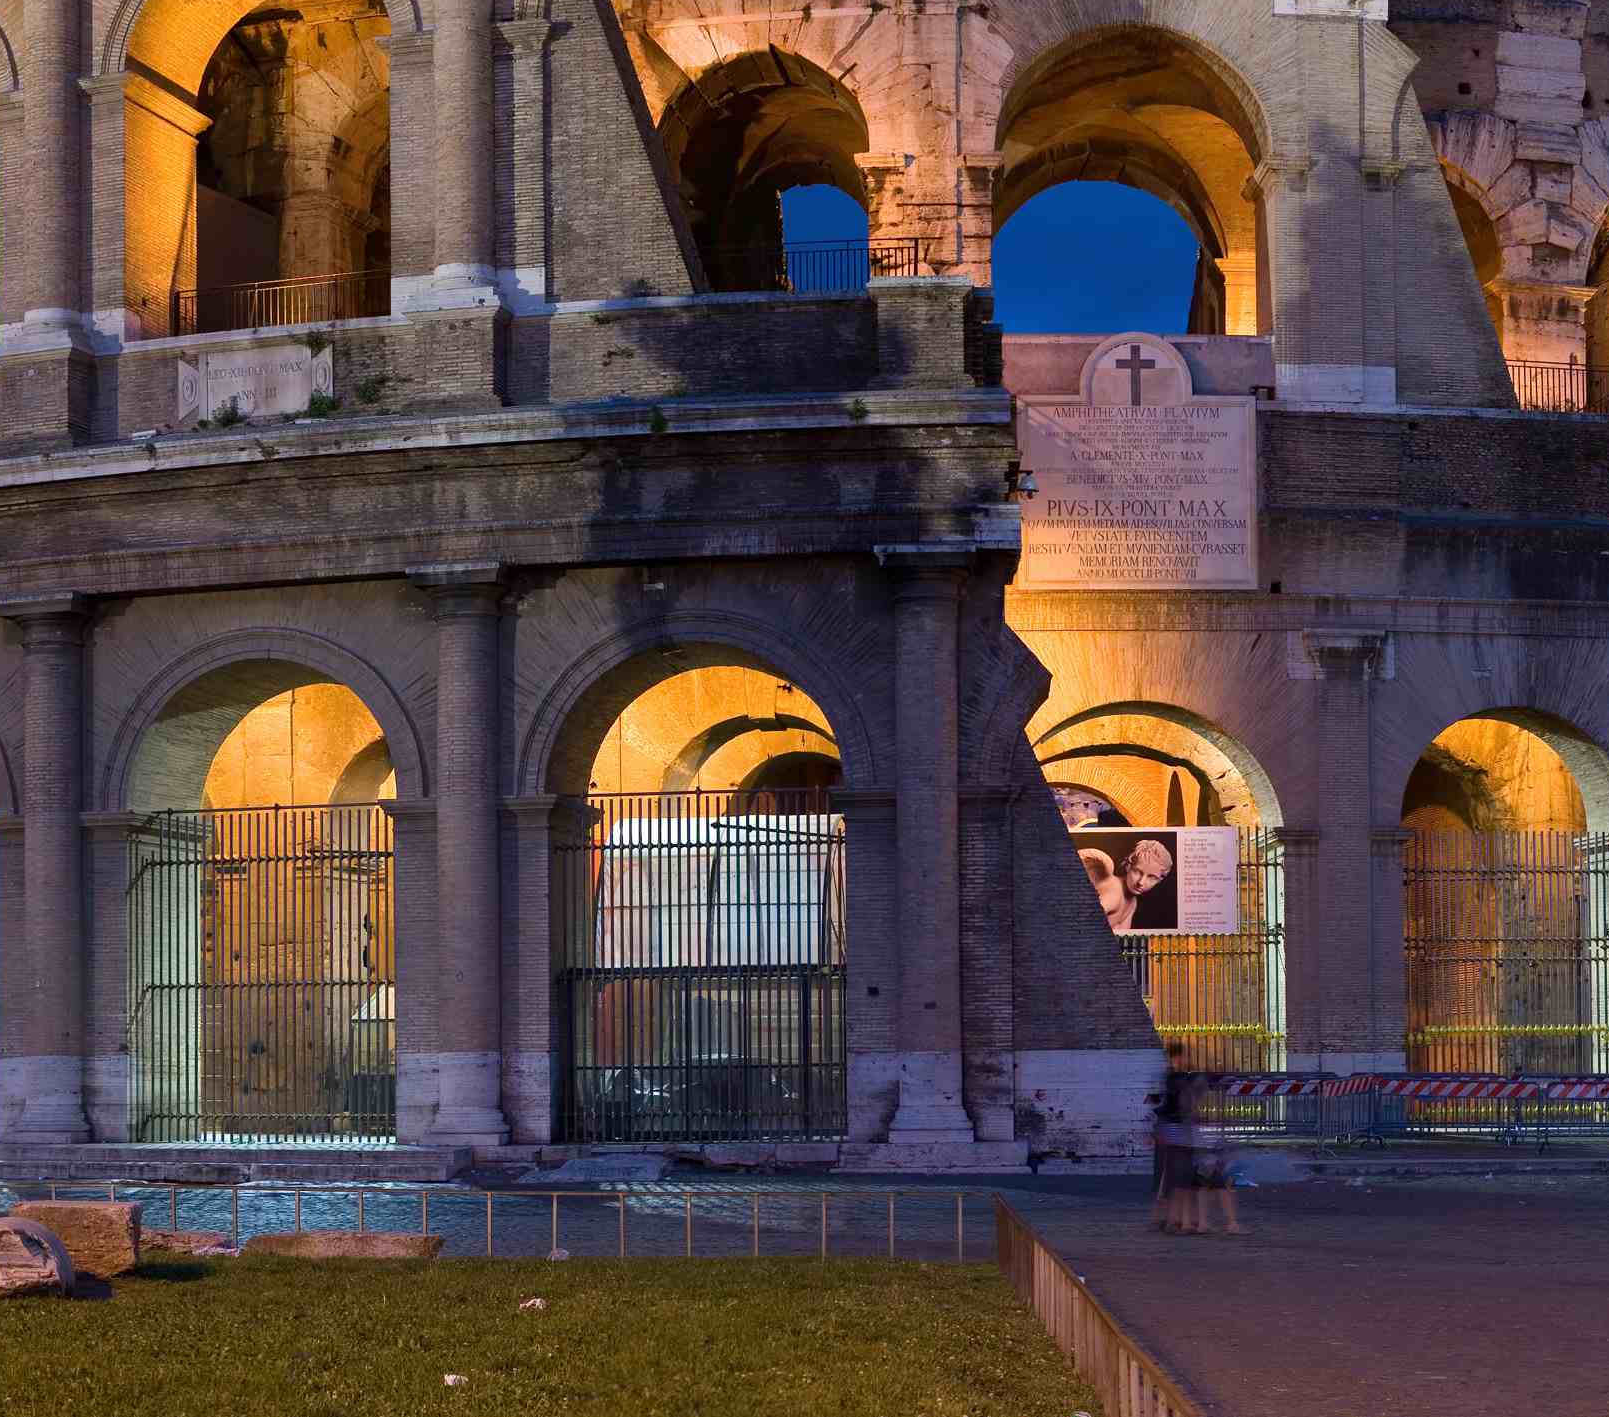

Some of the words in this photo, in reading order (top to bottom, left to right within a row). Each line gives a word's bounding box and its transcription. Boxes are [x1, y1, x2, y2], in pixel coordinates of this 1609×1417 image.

[279, 361, 303, 373] MAX
[1053, 407, 1157, 418] AMPHITHEATRVM
[1164, 407, 1220, 418] FLAVIVM
[1081, 451, 1135, 461] CLEMENTE
[1181, 451, 1204, 461] MAX
[1066, 474, 1128, 484] BENEDICTVS
[1154, 474, 1179, 484] PONT
[1184, 474, 1208, 484] MAX
[1047, 500, 1090, 517] PIVS
[1094, 500, 1113, 517] IX
[1121, 500, 1171, 517] PONT
[1179, 500, 1226, 517] MAX
[1134, 530, 1208, 542] FATISCENTEM
[1079, 556, 1139, 567] MEMORIAM
